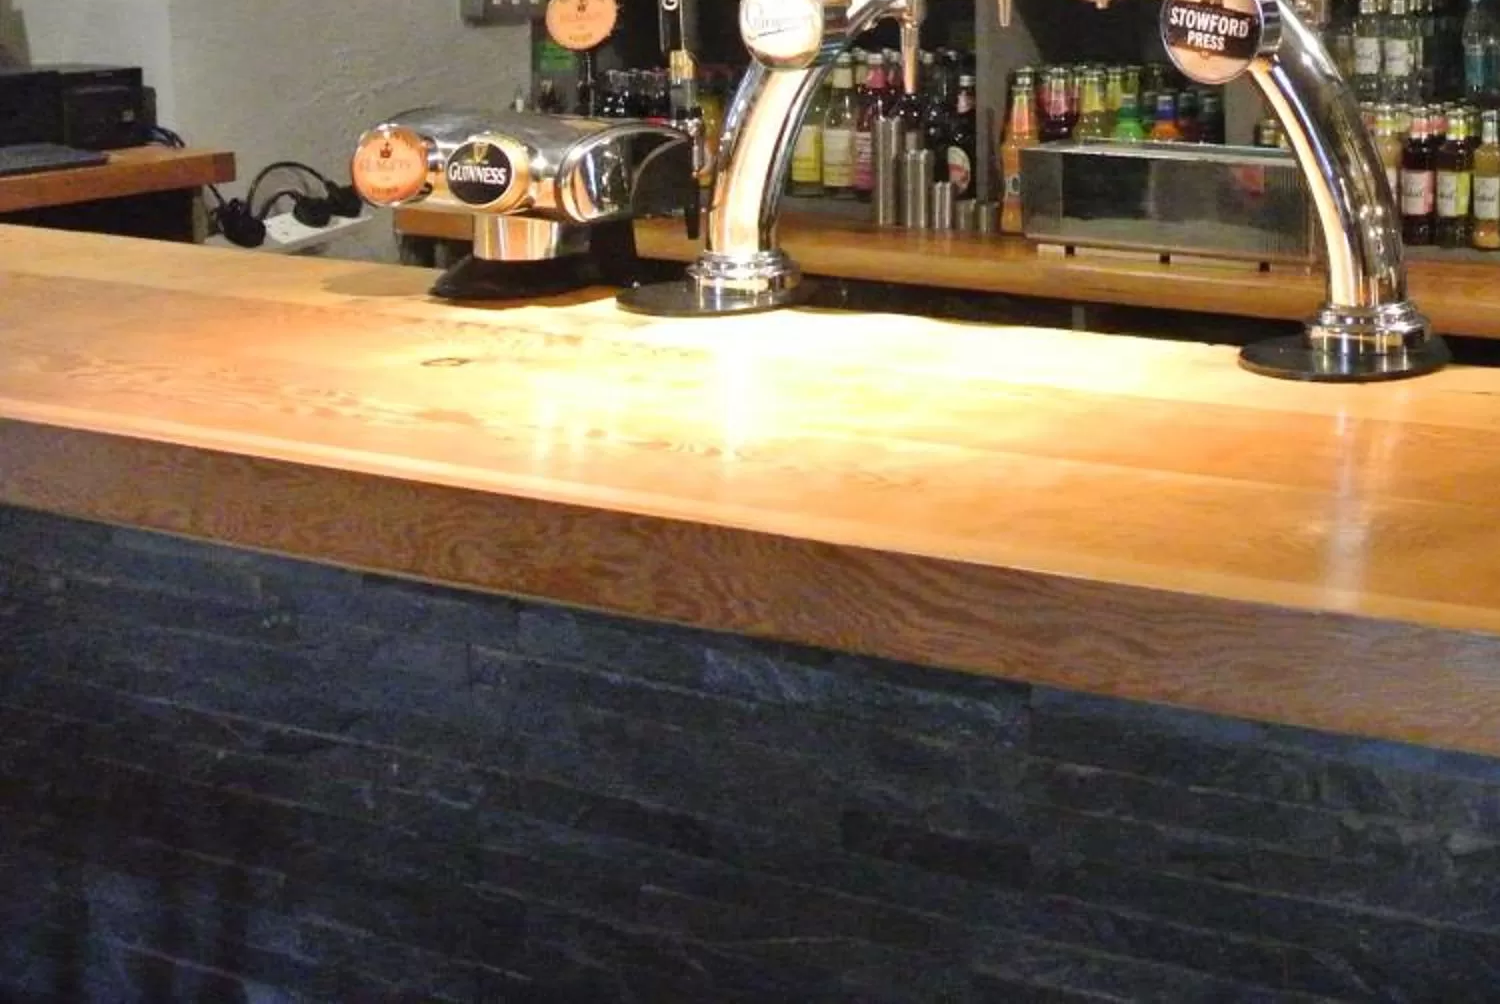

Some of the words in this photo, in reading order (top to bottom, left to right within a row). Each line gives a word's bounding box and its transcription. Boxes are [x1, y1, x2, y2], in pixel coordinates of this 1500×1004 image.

[1169, 6, 1249, 39] STOWFORD
[1187, 30, 1225, 51] PRESS
[449, 162, 507, 185] GUINNESS
